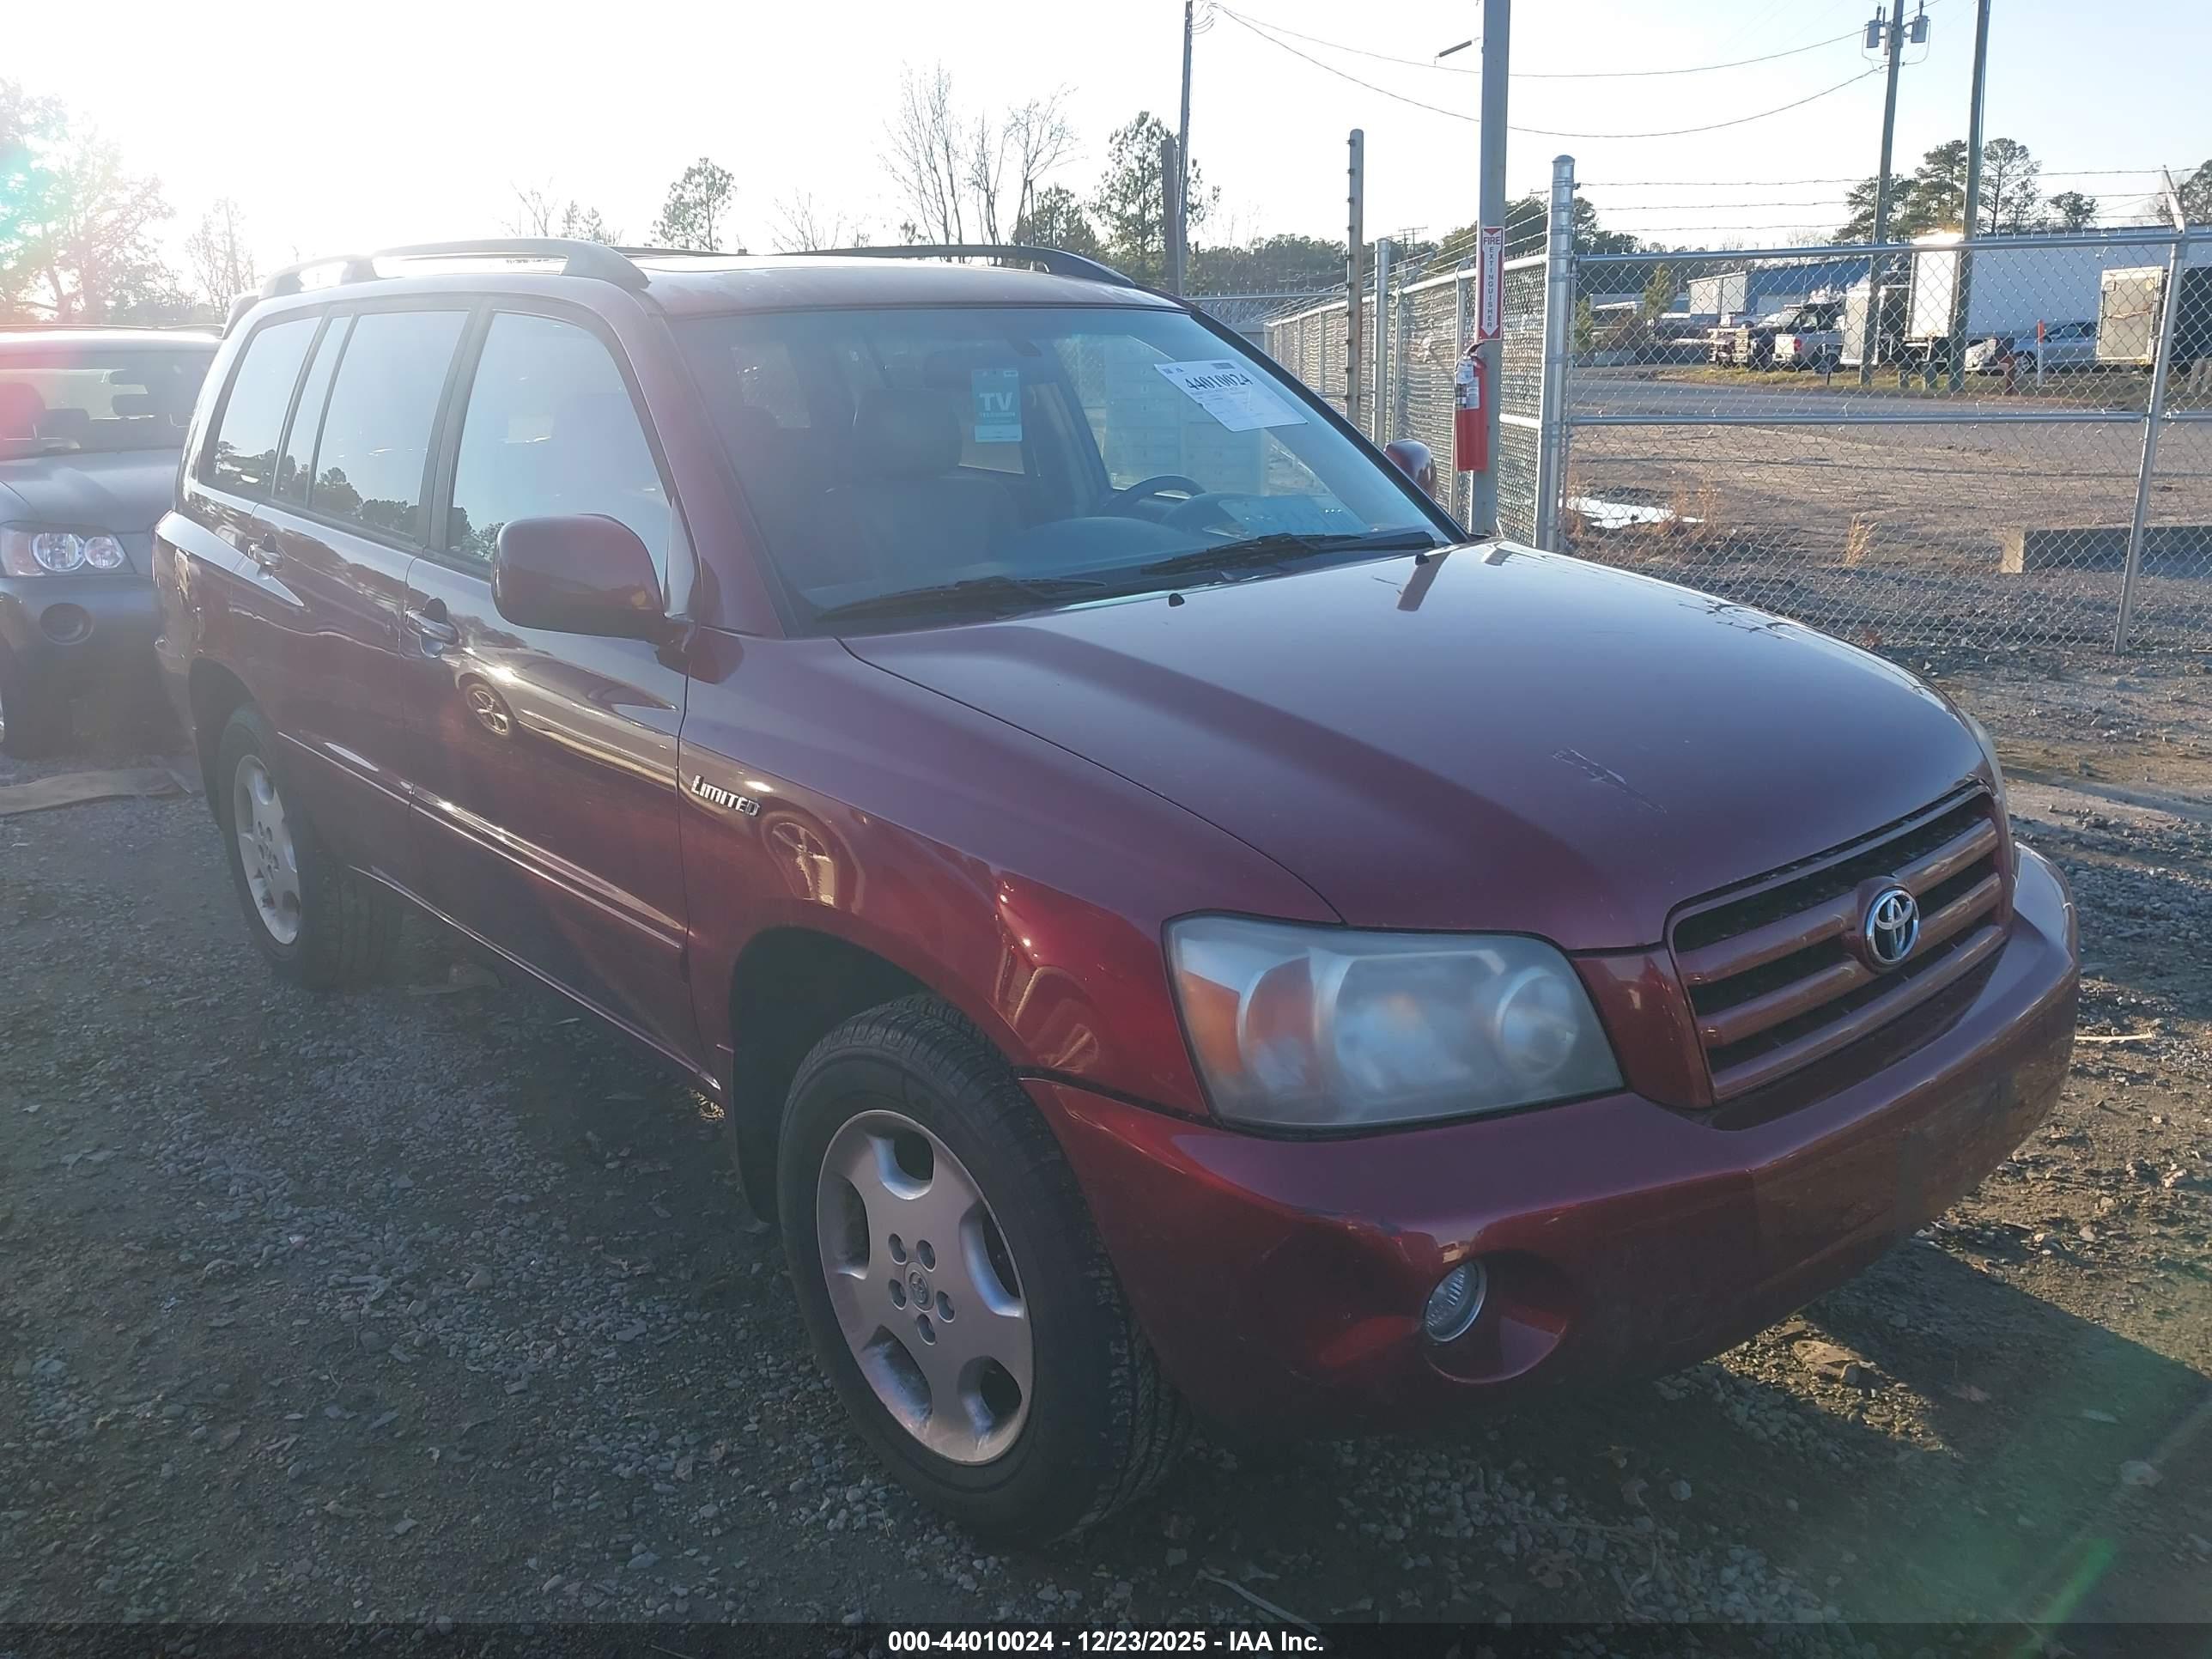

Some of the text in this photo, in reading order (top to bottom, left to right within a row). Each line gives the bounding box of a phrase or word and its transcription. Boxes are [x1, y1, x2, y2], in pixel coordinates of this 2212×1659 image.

[1483, 236, 1501, 245] FIRE
[1486, 246, 1495, 328] EXTINGUISHER
[1185, 373, 1254, 390] 44010024
[979, 392, 1013, 411] TV
[691, 775, 761, 817] LIMITED
